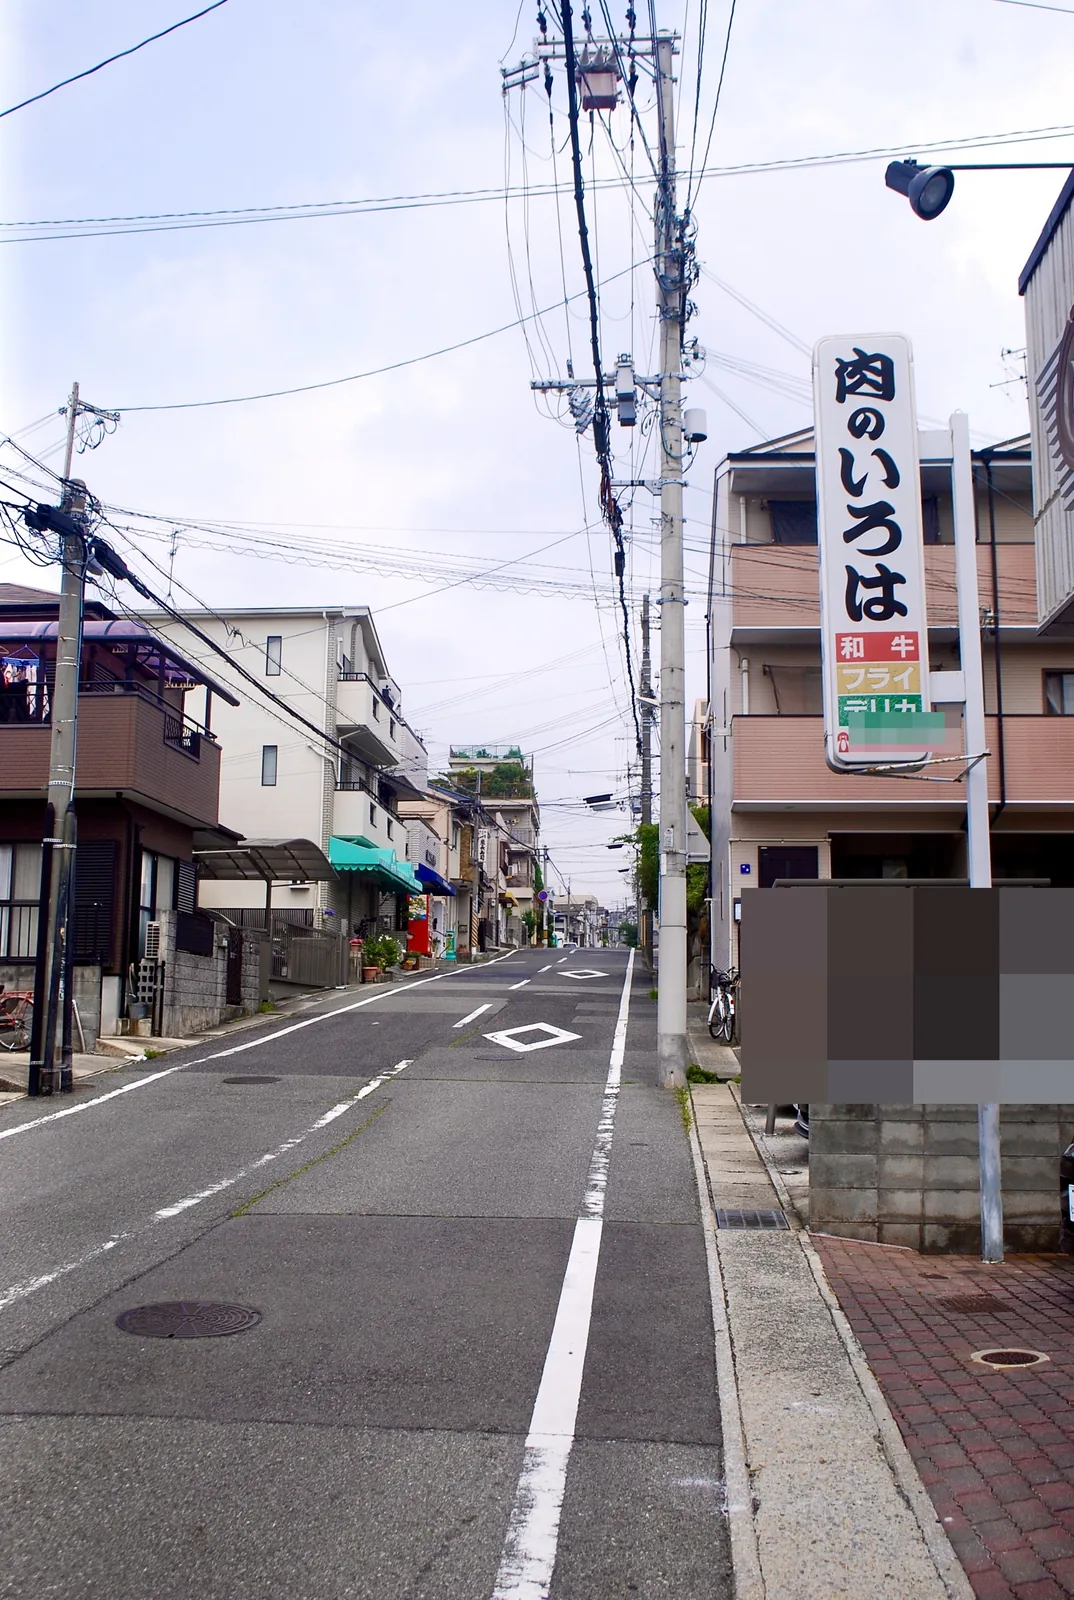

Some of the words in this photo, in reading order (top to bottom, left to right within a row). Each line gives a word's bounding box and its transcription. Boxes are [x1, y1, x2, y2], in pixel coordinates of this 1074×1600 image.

[835, 347, 908, 622] 肉のいろは
[843, 667, 914, 691] フライ
